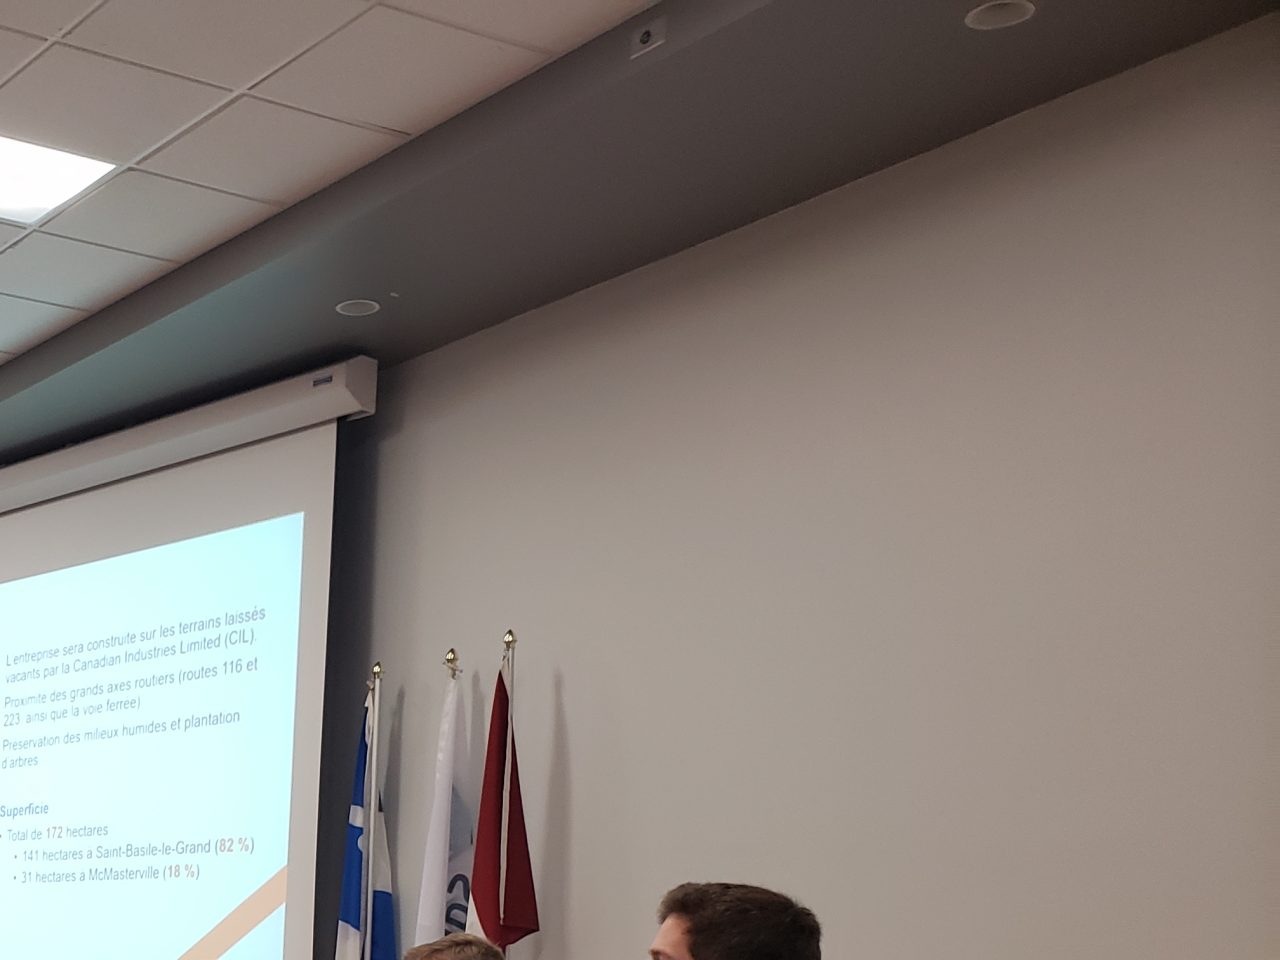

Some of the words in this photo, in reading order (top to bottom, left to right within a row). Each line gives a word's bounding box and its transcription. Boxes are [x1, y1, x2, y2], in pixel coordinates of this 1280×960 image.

[6, 648, 60, 667] Lentreprise
[62, 643, 84, 656] sera
[87, 632, 137, 651] construite
[140, 628, 157, 642] sur
[159, 624, 175, 638] les
[179, 616, 221, 634] terrains
[225, 605, 266, 626] laissés
[5, 667, 41, 684] vacants
[43, 665, 60, 680] par
[61, 663, 70, 674] la
[73, 654, 121, 673] Canadian
[124, 644, 177, 663] Industries
[180, 634, 221, 654] Limited
[49, 689, 67, 702] des
[70, 683, 104, 702] grands
[107, 679, 132, 693] axes
[134, 673, 175, 689] routiers
[178, 666, 218, 685] (routes
[222, 658, 242, 675] 116
[246, 656, 258, 672] et
[25, 711, 47, 724] ainsi
[50, 708, 68, 723] que
[71, 705, 80, 717] la
[83, 702, 103, 716] voie
[63, 731, 81, 744] des
[84, 727, 119, 741] milieux
[122, 720, 167, 737] humides
[170, 717, 181, 731] et
[184, 711, 240, 732] plantation
[1, 755, 39, 769] darbres
[0, 802, 49, 819] Superficie
[7, 829, 28, 841] Total
[30, 828, 42, 840] de
[46, 825, 63, 839] 172
[66, 825, 109, 838] hectares
[23, 849, 39, 862] 141
[42, 848, 83, 861] hectares
[95, 839, 211, 859] Saint-Basile-le-Grand
[214, 837, 234, 856] (82
[237, 836, 255, 855] %)
[21, 871, 32, 884] 31
[35, 870, 77, 883] hectares
[88, 866, 160, 881] McMasterville
[162, 864, 181, 881] (18
[184, 863, 200, 880] %)
